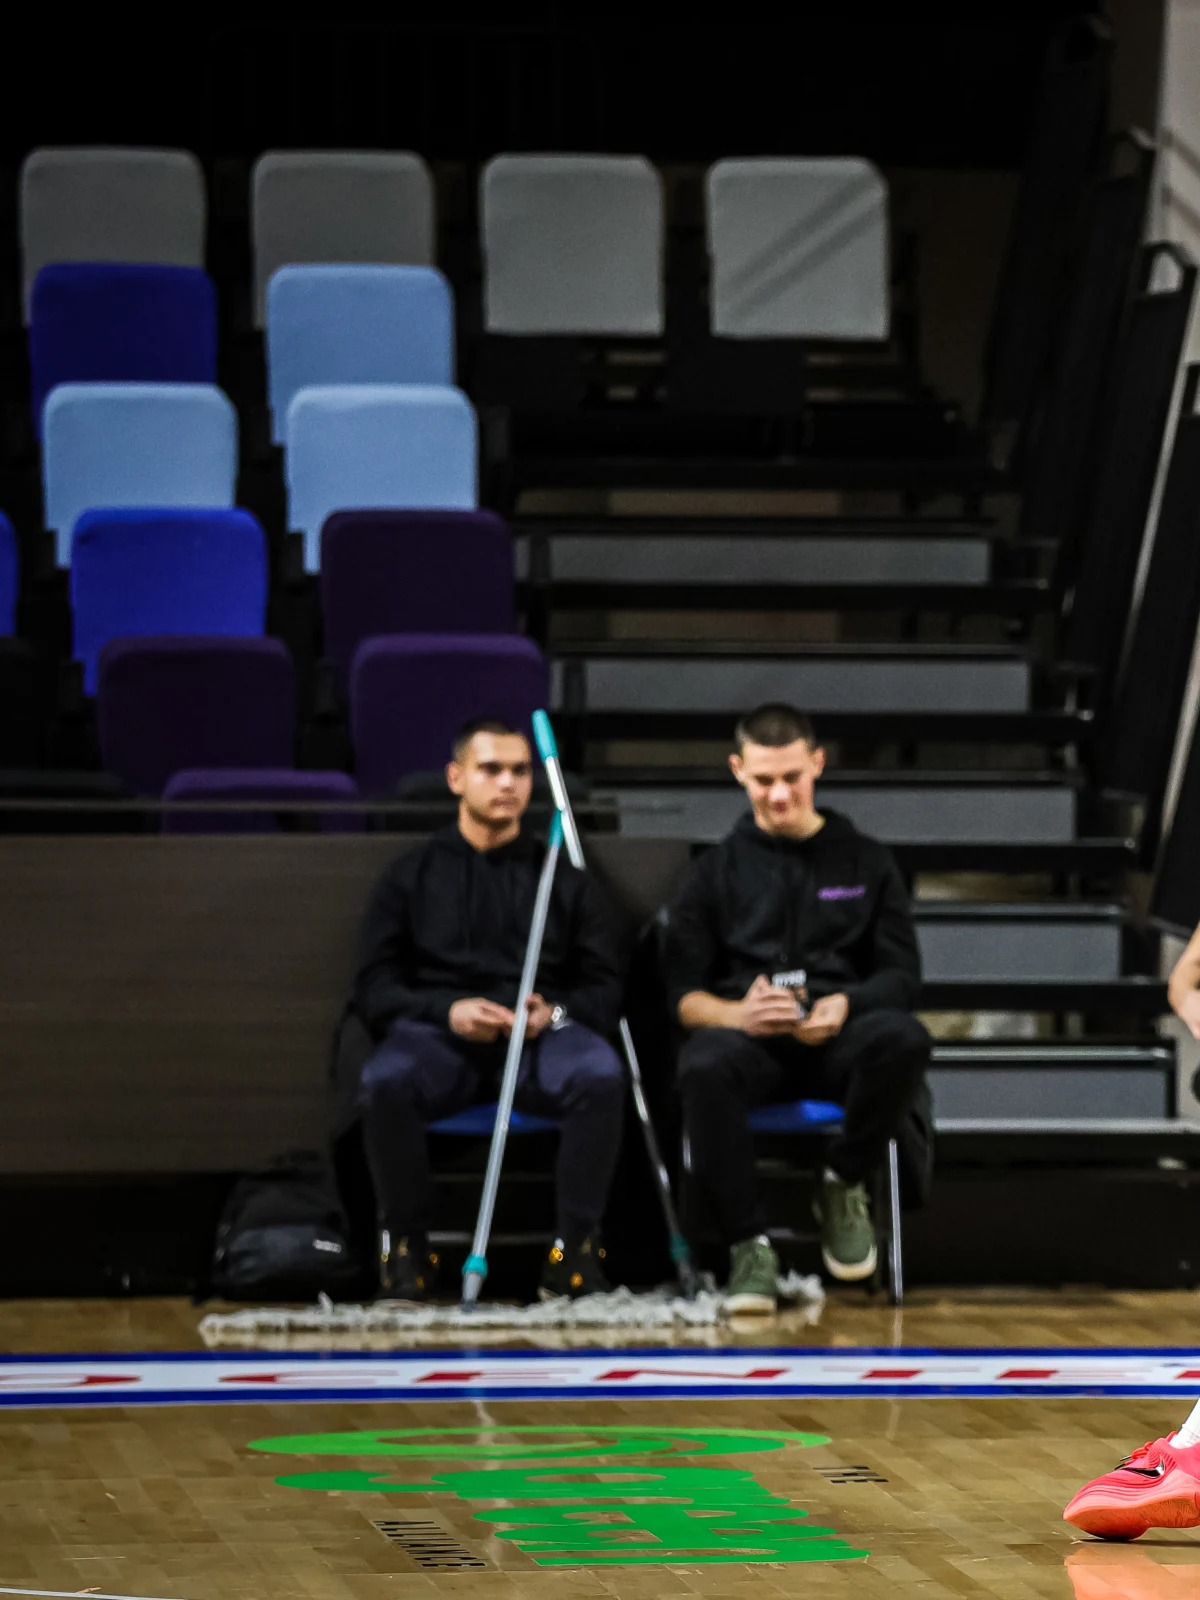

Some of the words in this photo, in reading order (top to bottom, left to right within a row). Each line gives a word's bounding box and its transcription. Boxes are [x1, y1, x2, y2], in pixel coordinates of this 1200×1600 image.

[813, 1466, 889, 1484] THE
[274, 1466, 871, 1566] green
[372, 1520, 487, 1567] ALLIANCE
